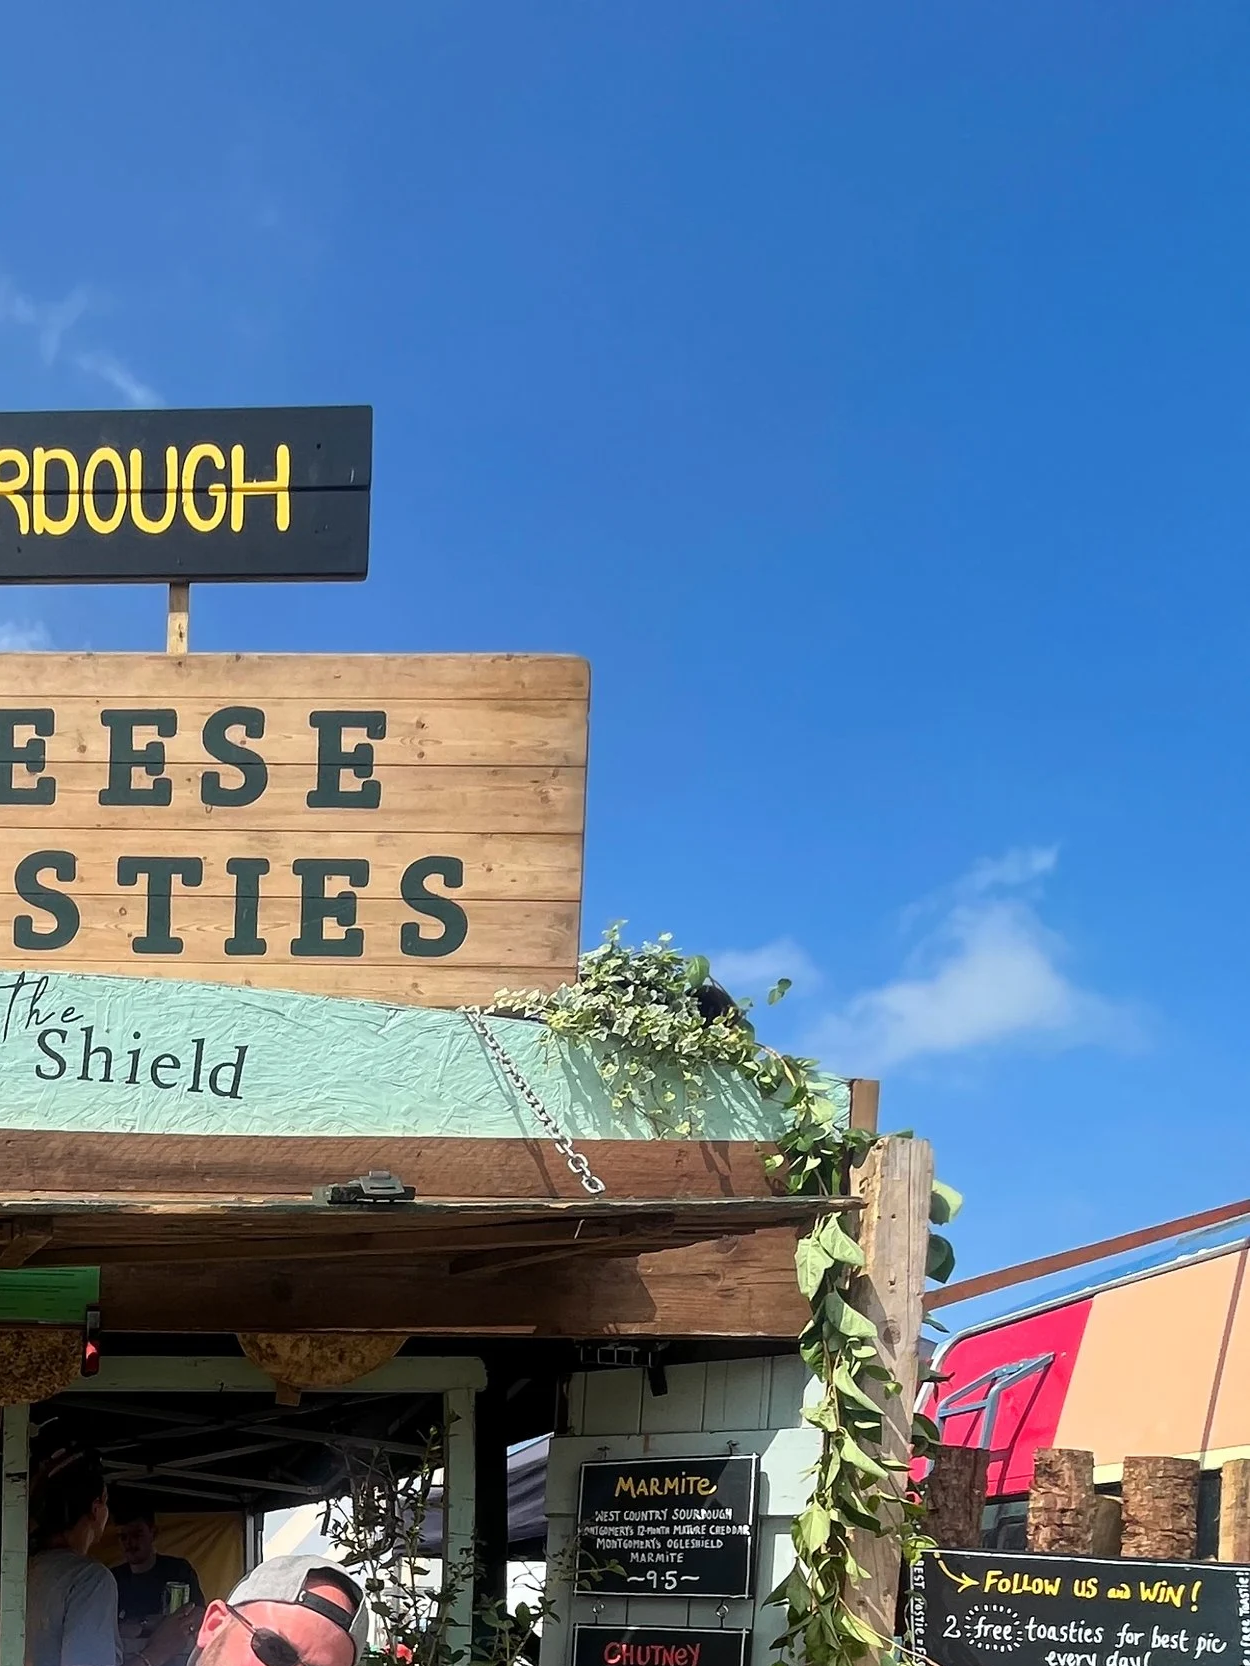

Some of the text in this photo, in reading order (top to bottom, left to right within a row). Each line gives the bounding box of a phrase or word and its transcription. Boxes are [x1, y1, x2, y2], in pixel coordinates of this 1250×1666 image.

[35, 1027, 248, 1101] Shield
[623, 1508, 668, 1522] COUNTRY
[671, 1508, 733, 1521] SOURDOUGH
[942, 1615, 1227, 1660] 2 free toasties for best pic
